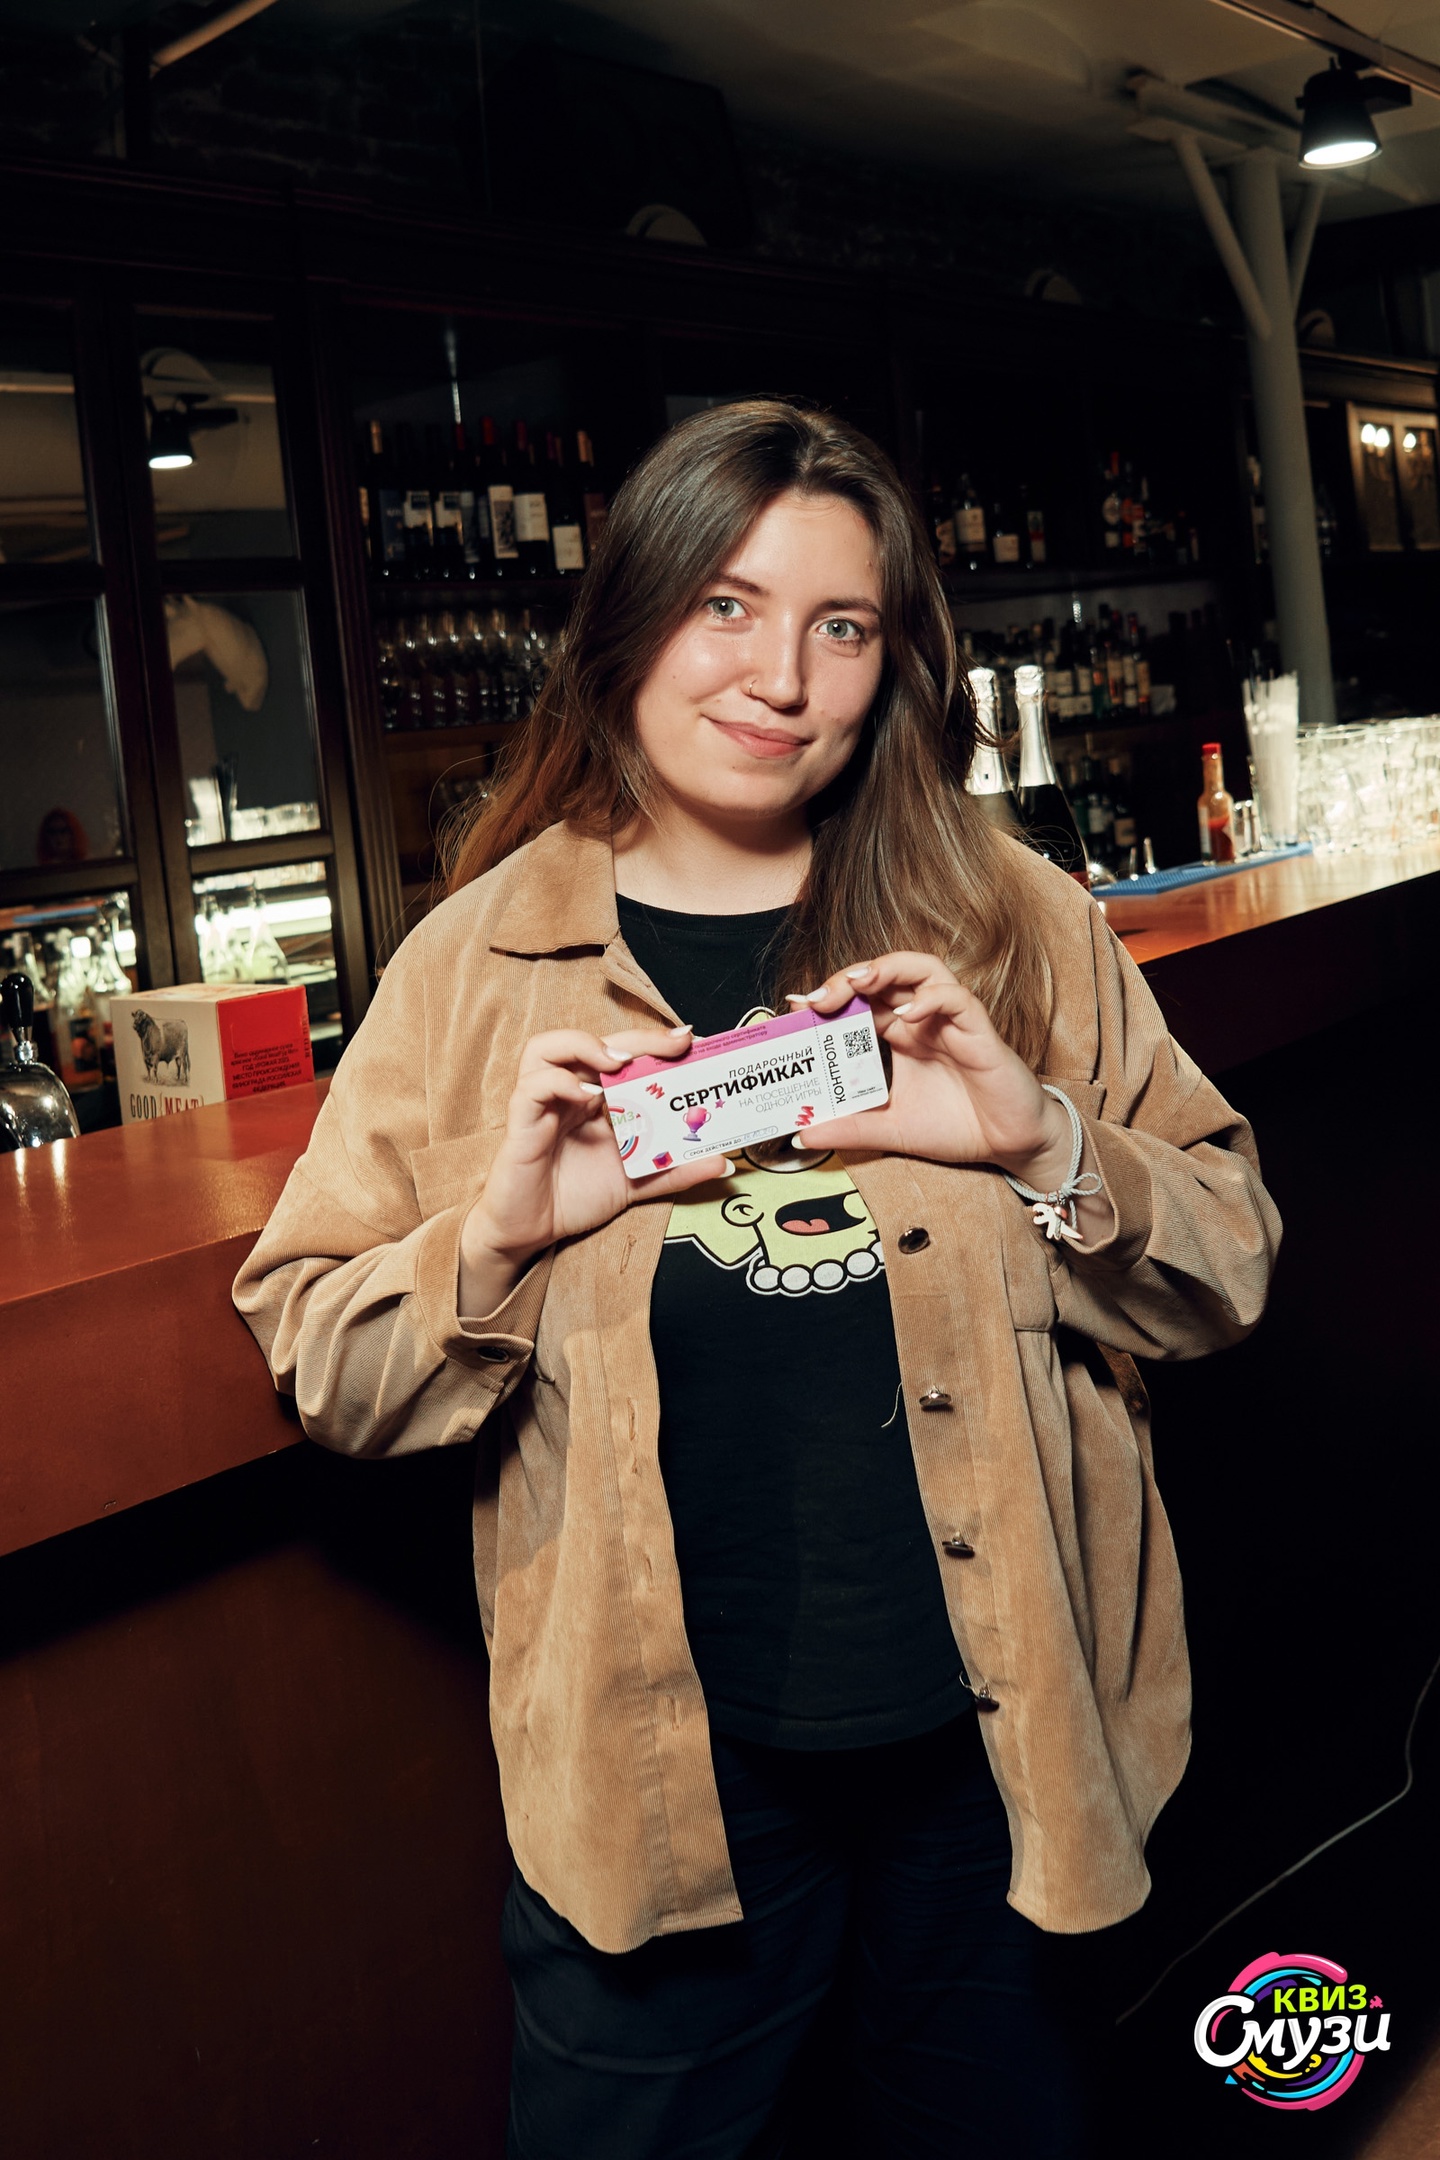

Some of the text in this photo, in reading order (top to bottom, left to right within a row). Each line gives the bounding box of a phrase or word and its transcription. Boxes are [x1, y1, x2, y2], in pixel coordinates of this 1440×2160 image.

[694, 1034, 730, 1049] подарочного
[730, 1024, 767, 1041] сертификата
[722, 1029, 768, 1046] администратору
[232, 1062, 300, 1081] МЕСТО ПРОИСХОЖДЕНИЯ
[242, 1063, 254, 1071] ГОД
[266, 1069, 302, 1081] РОССИЙСКАЯ
[729, 1046, 814, 1079] ПОДАРОЧНЫЙ
[823, 1034, 847, 1104] КОНТРОЛЬ
[669, 1056, 815, 1112] СЕРТИФИКАТ
[738, 1077, 821, 1109] НА ПОСЕЩЕНИЕ
[130, 1093, 157, 1119] GOOD
[755, 1087, 822, 1113] ОДНОЙ ИГРЫ
[689, 1149, 704, 1157] СРОК
[704, 1140, 733, 1153] ДЕЙСТВИЯ
